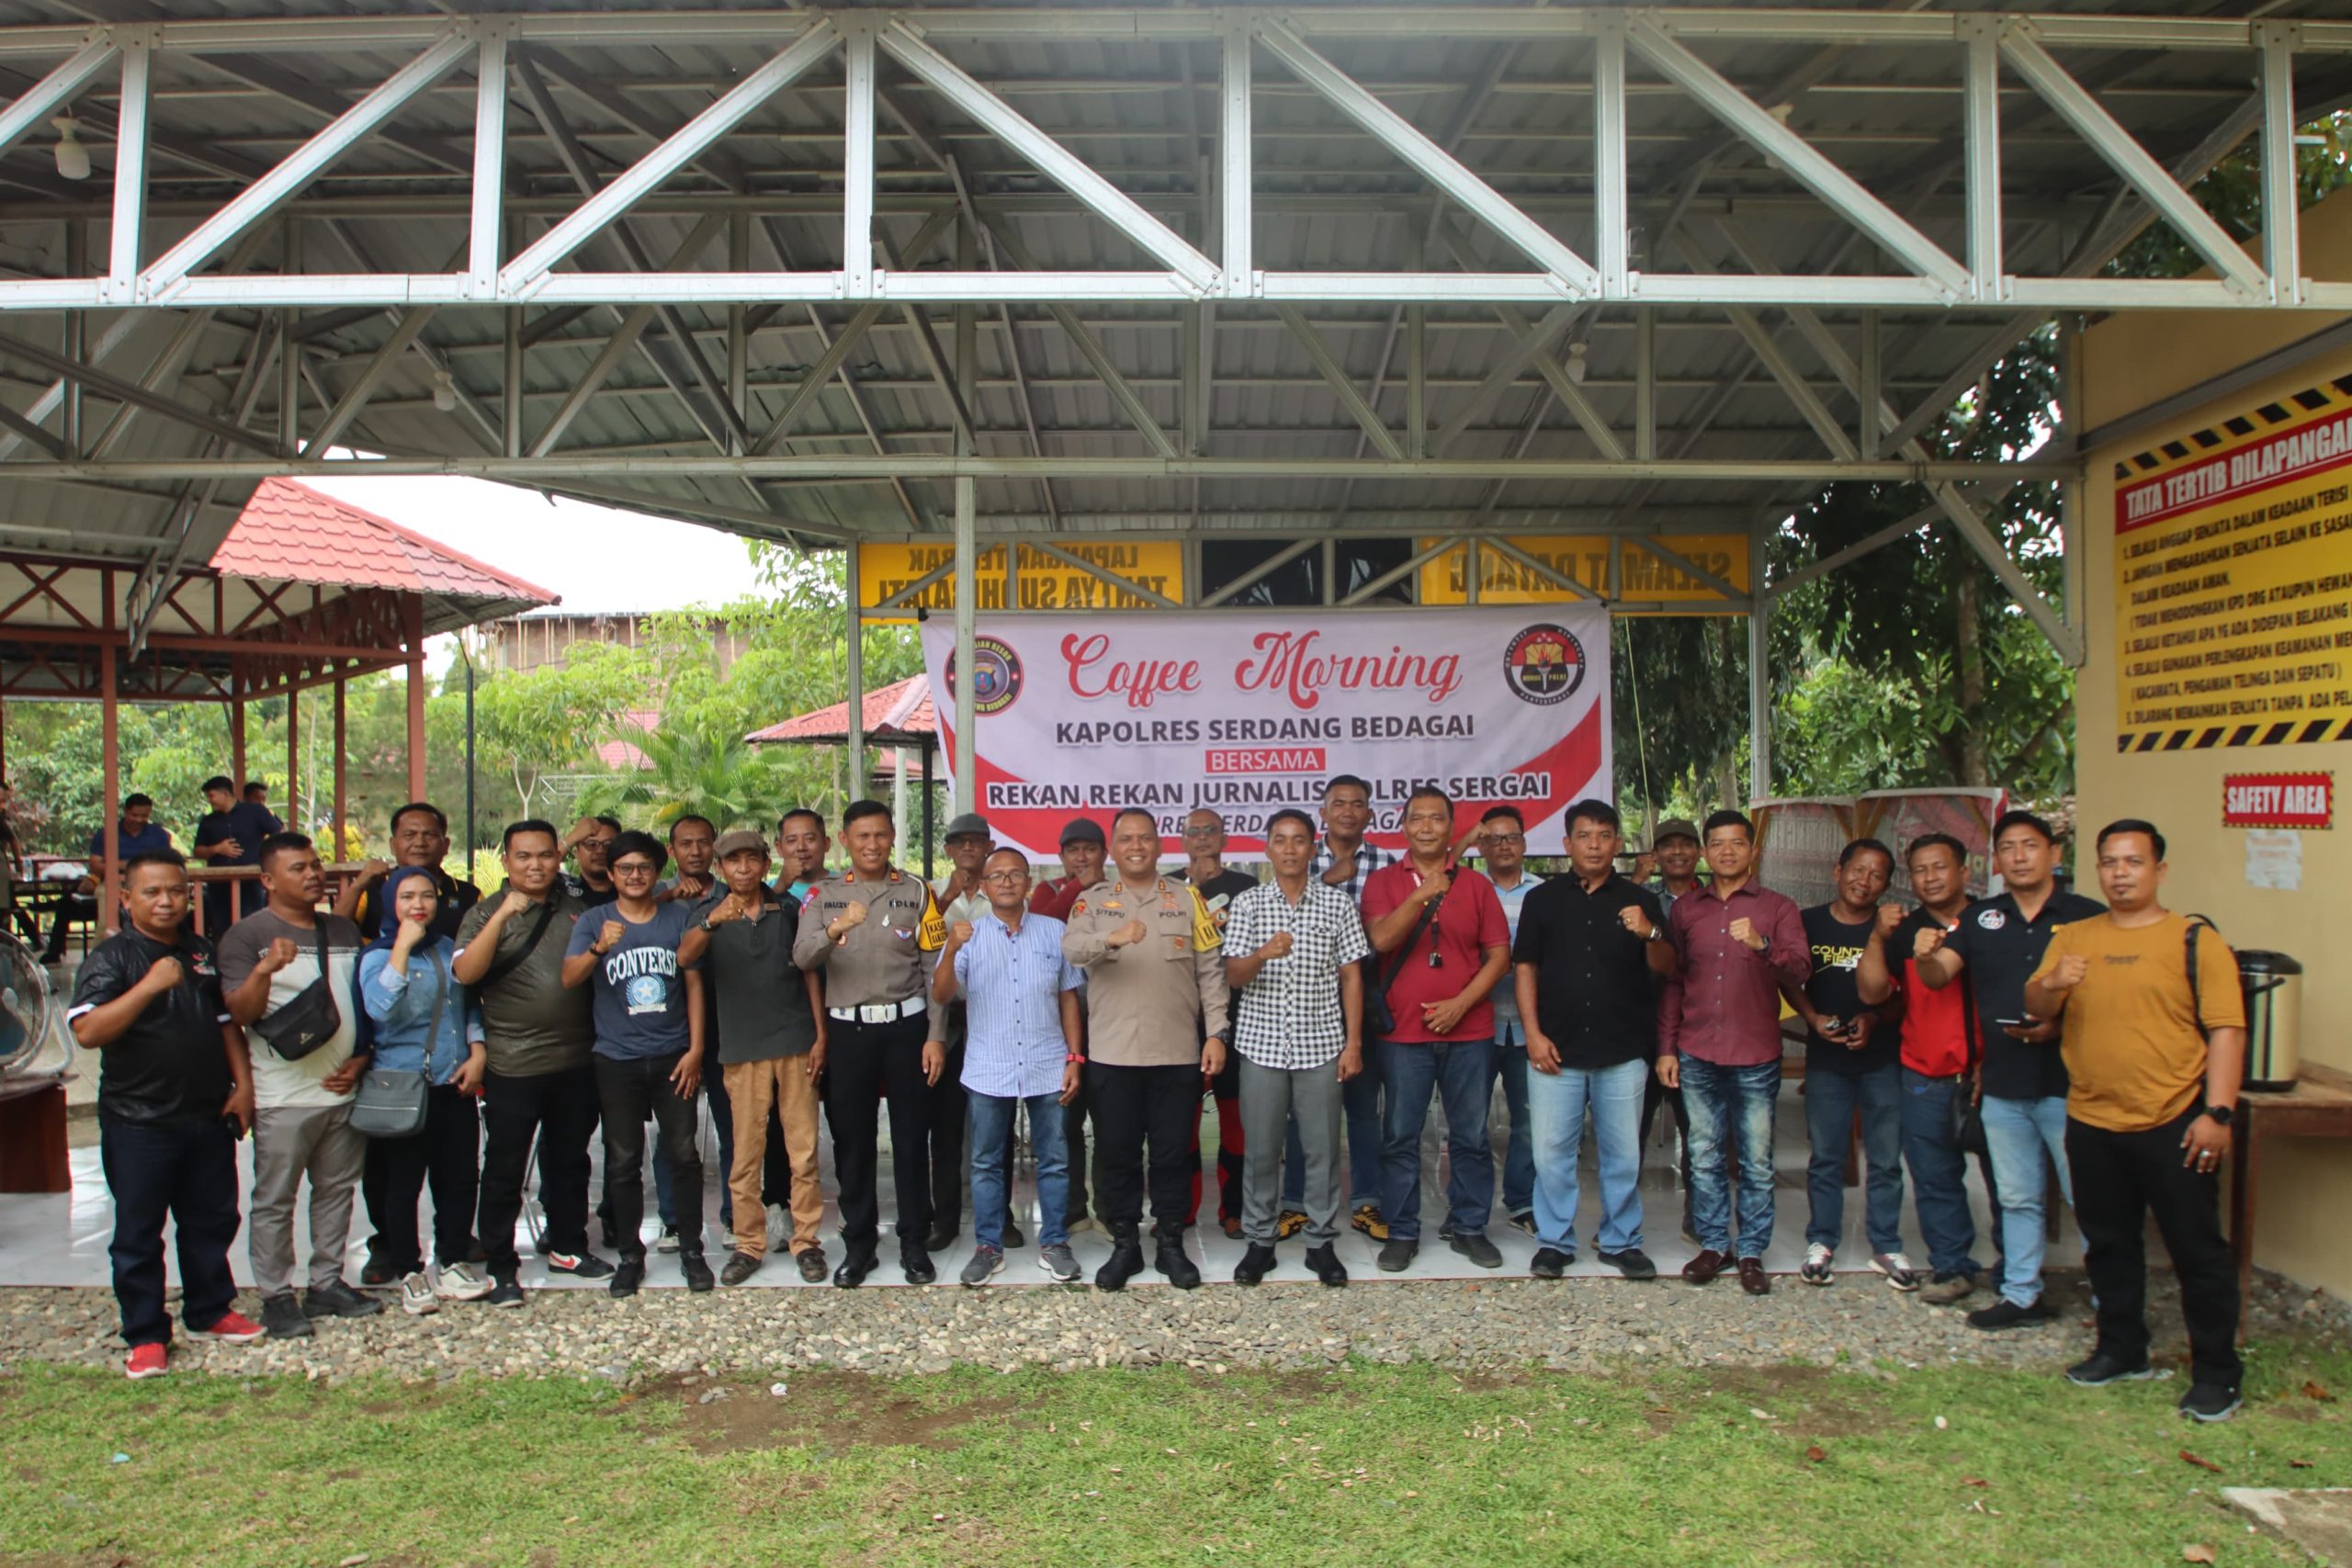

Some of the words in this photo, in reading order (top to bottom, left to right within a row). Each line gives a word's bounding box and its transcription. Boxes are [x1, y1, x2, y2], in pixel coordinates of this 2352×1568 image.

[2126, 482, 2163, 520] TATA
[2165, 461, 2227, 508] TERTIB
[2194, 519, 2231, 542] SENJATA
[2233, 508, 2266, 531] DALAM
[2267, 494, 2314, 521] KEADAAN
[2317, 484, 2348, 507] TERISI
[2165, 546, 2231, 573] MENGARAHKAN
[2233, 535, 2271, 558] SENJATA
[2274, 525, 2307, 547] SELAIN
[2309, 521, 2322, 538] KE
[2227, 594, 2245, 611] KPD
[2247, 589, 2266, 607] ORG
[2268, 580, 2314, 603] ATAUPUN
[2199, 626, 2215, 642] APA
[2218, 623, 2229, 638] YG
[2231, 619, 2249, 637] ADA
[2252, 613, 2293, 633] DIDEPAN
[2296, 602, 2348, 626] BELAKANG
[2205, 644, 2272, 666] PERLENGKAPAN
[2275, 635, 2332, 657] KEAMANAN
[1060, 633, 1202, 707] Coffee
[1235, 629, 1463, 709] Morning
[2234, 671, 2270, 689] TELINGA
[2274, 668, 2295, 684] DAN
[2230, 697, 2267, 716] SENJATA
[2270, 694, 2303, 712] TANPA
[2308, 692, 2330, 708] ADA
[1056, 720, 1200, 744] KAPOLRES
[1208, 717, 1341, 741] SERDANG
[1351, 714, 1475, 739] BEDAGAI
[1212, 749, 1318, 771] BERSAMA
[989, 784, 1080, 806] REKAN
[1091, 784, 1183, 805] REKAN
[1449, 774, 1549, 798] SERGAI
[2227, 785, 2282, 814] SAFETY
[2283, 785, 2327, 815] AREA
[1095, 908, 1125, 919] SITEPU
[1159, 910, 1187, 919] POLRI
